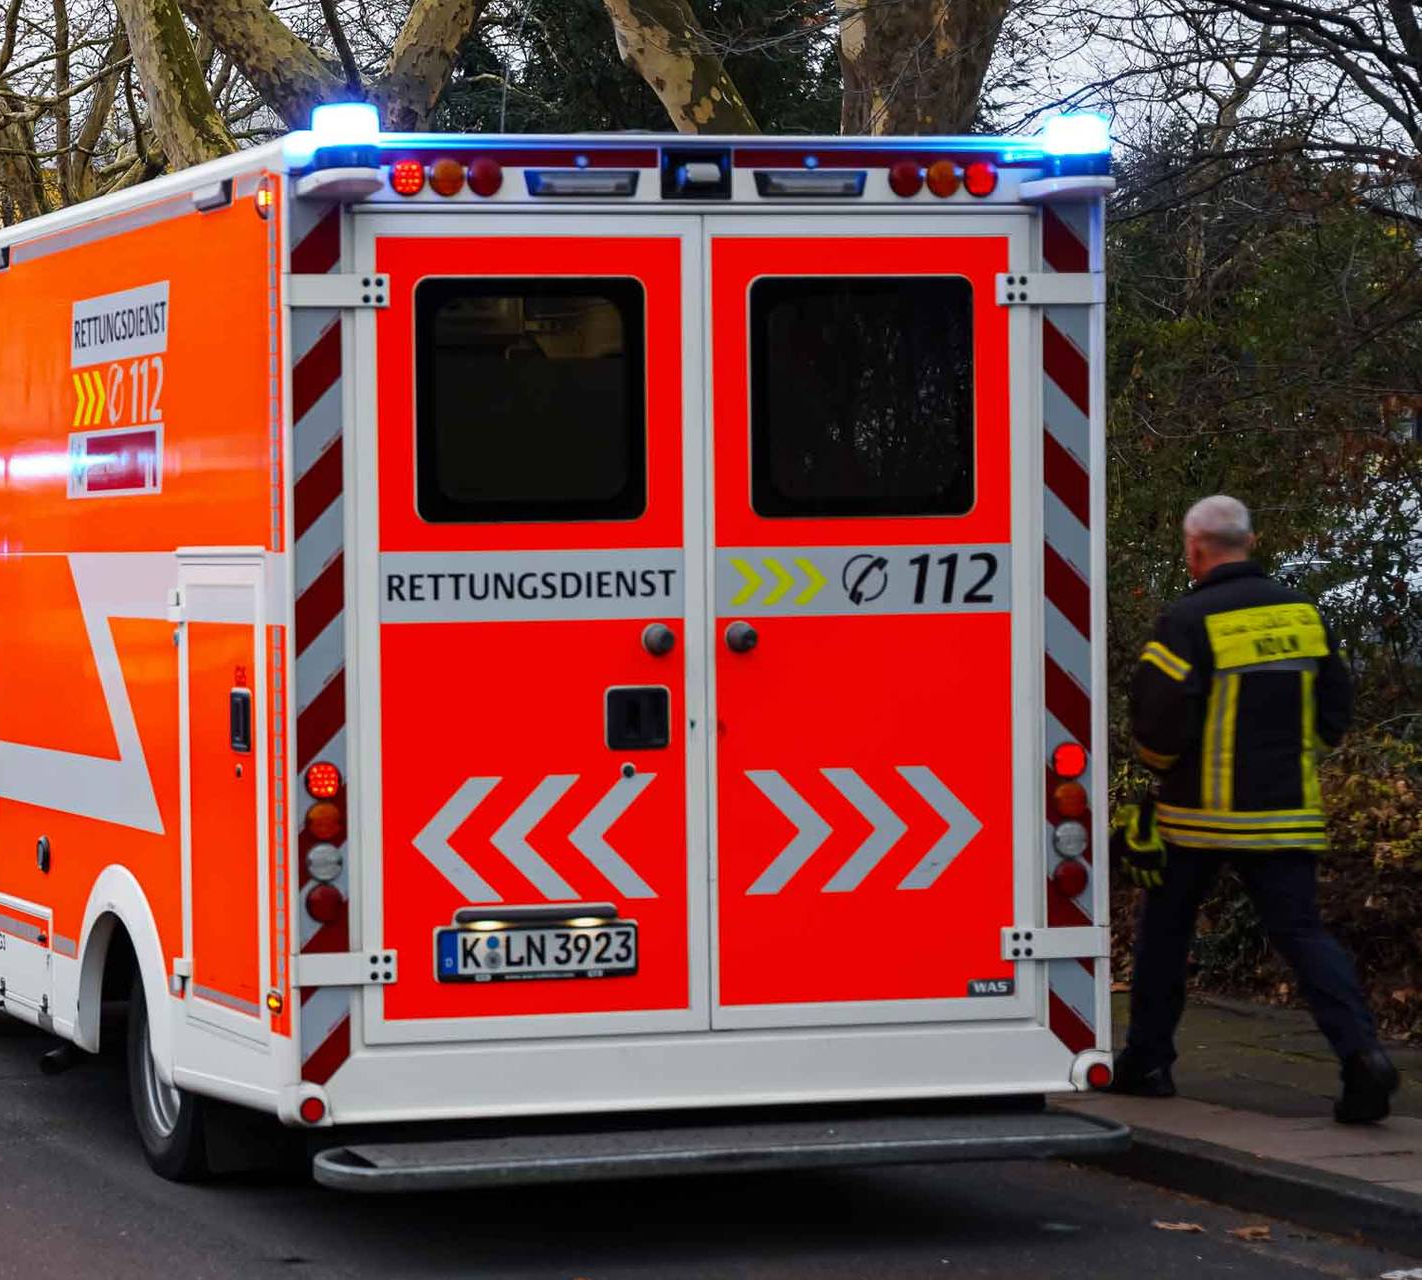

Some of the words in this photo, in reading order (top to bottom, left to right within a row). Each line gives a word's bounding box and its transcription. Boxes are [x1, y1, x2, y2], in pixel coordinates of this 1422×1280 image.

[74, 301, 167, 350] RETTUNGSDIENST
[129, 356, 164, 424] 112
[386, 570, 677, 602] RETTUNGSDIENST
[907, 551, 999, 606] 112
[462, 936, 482, 969] K
[505, 934, 547, 967] LN
[554, 930, 633, 965] 3923
[974, 981, 1010, 993] WAS
